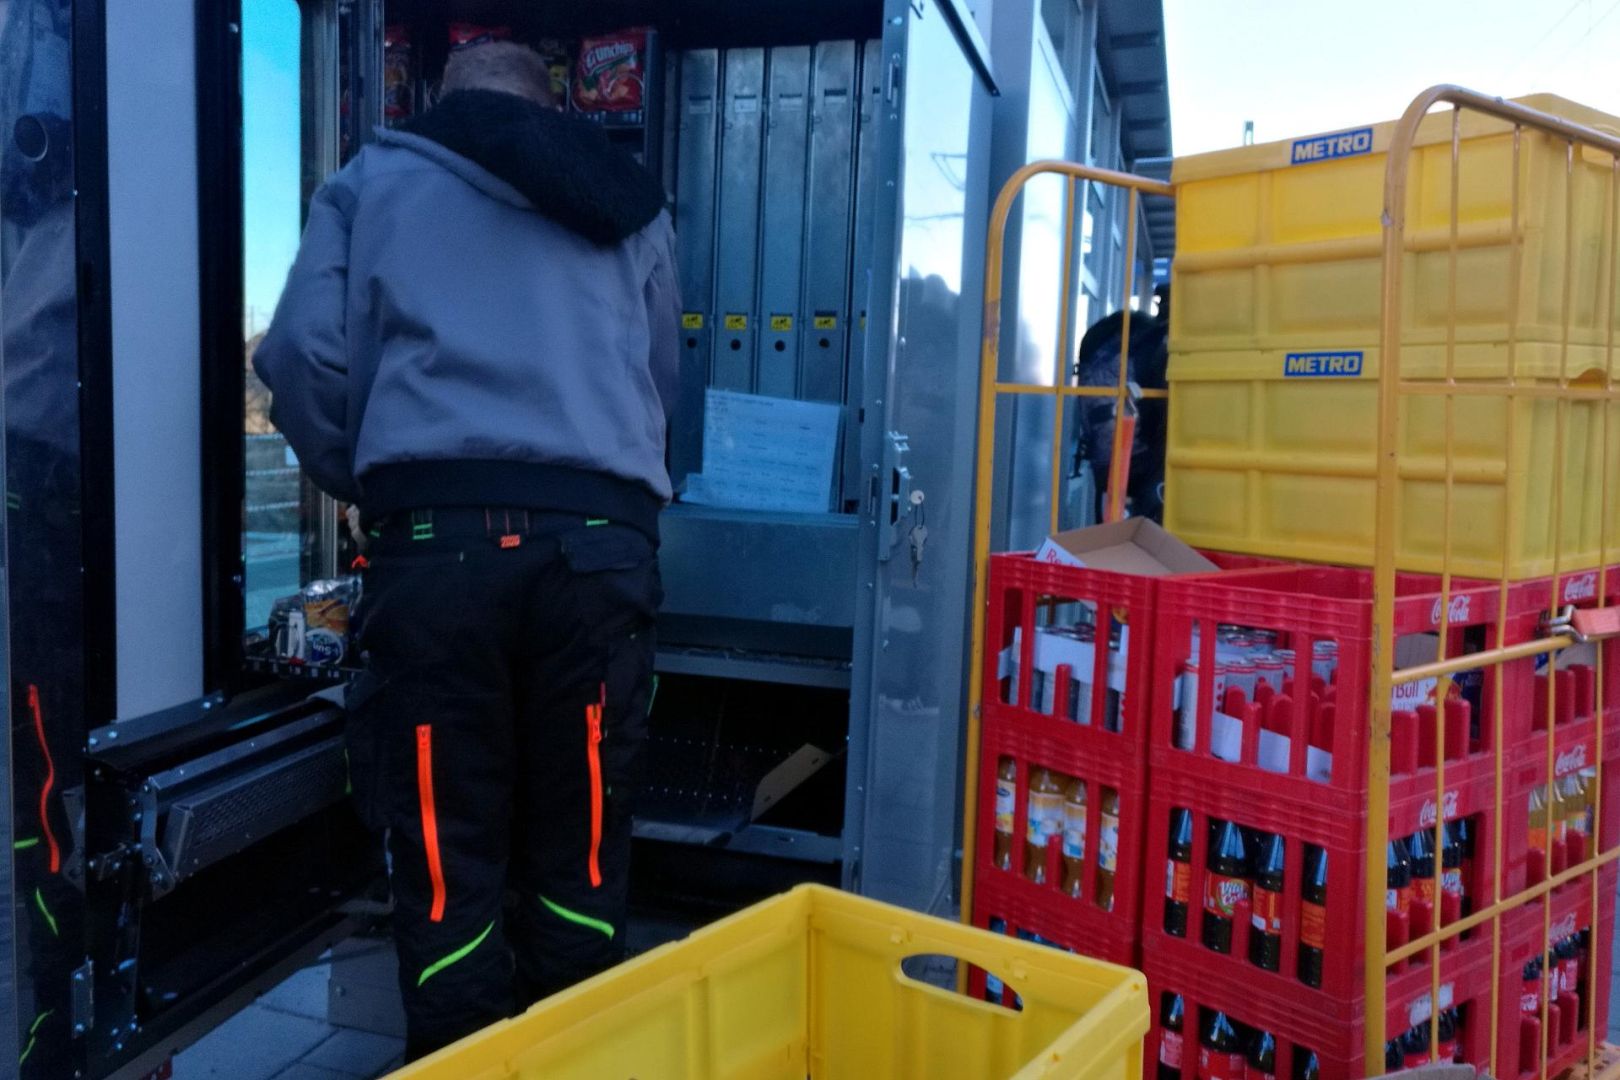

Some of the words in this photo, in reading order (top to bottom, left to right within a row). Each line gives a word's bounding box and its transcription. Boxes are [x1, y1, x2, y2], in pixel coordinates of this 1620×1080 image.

[1295, 132, 1369, 161] METRO
[1288, 356, 1359, 373] METRO
[1396, 679, 1418, 698] Bull
